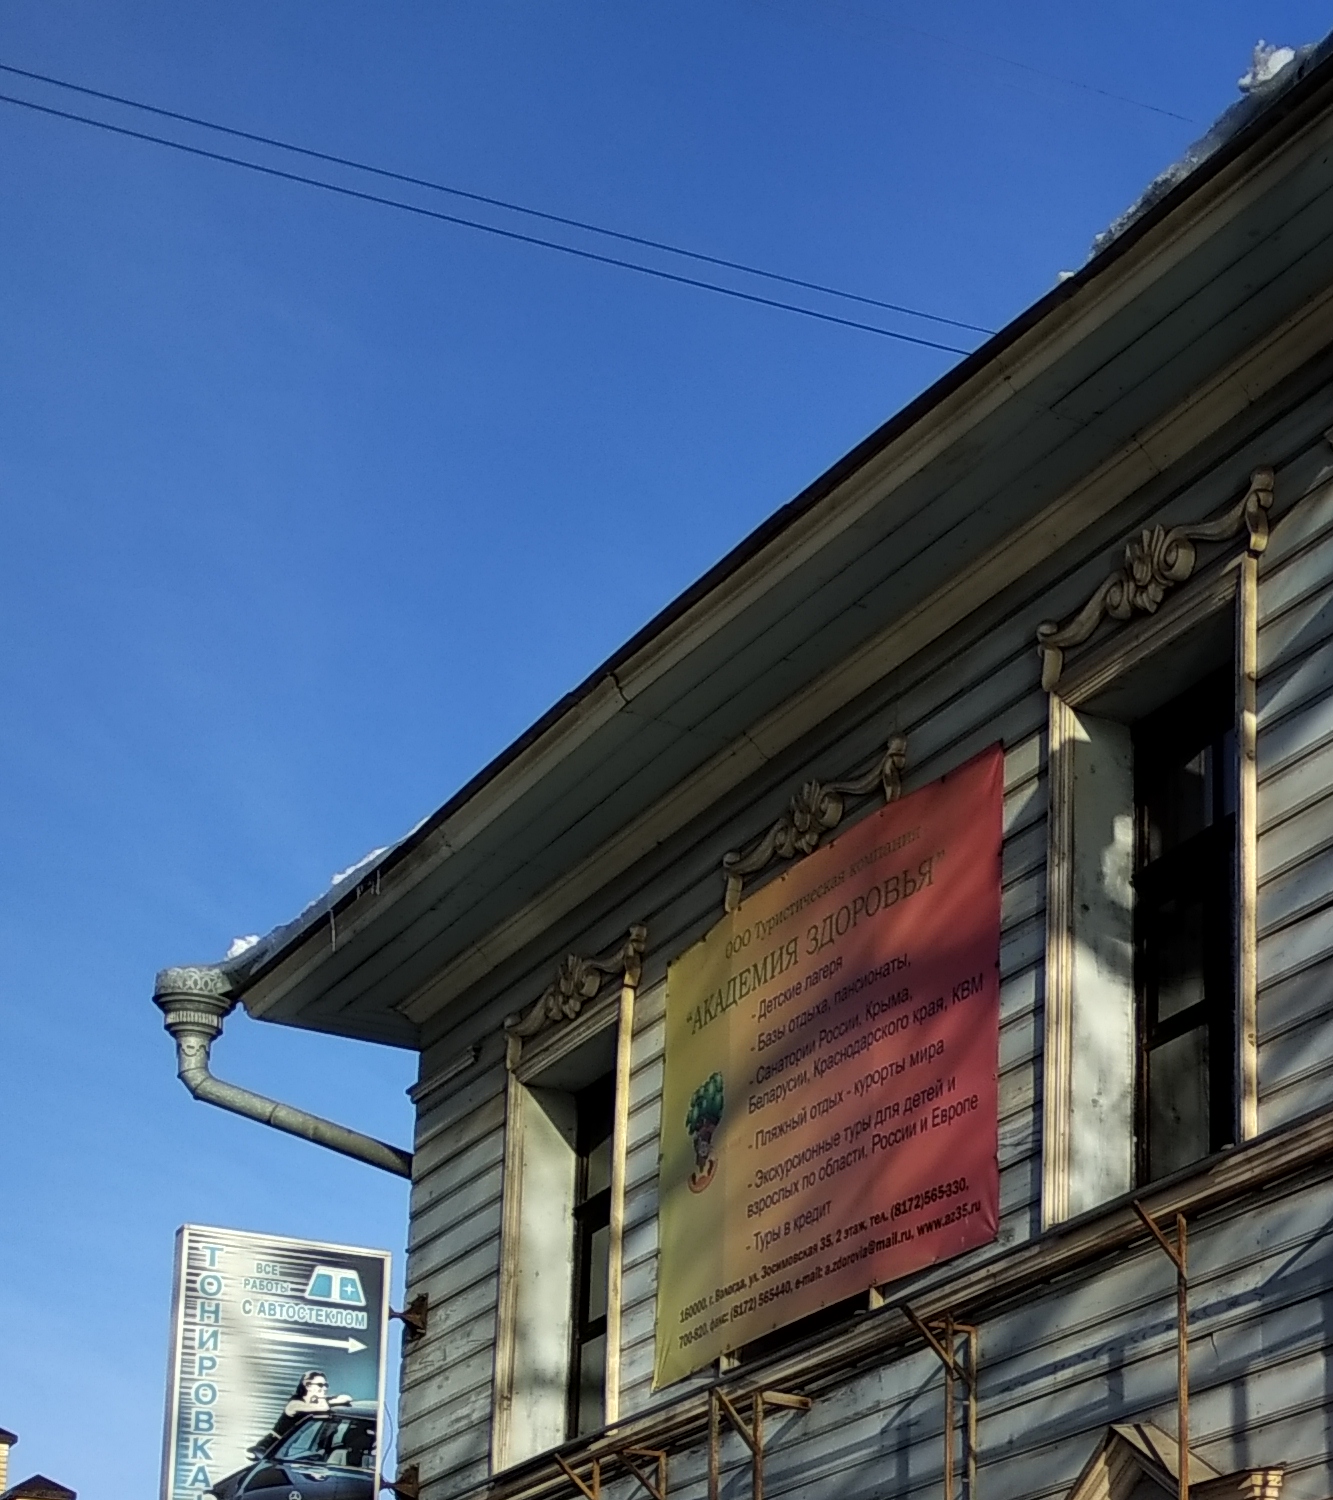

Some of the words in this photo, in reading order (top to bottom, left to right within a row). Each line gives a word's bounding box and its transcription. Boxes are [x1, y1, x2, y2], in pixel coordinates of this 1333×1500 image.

[725, 928, 752, 960] ООО
[754, 871, 845, 938] Туристическая
[849, 826, 921, 877] компания
[756, 1039, 816, 1085] Санатории
[865, 987, 913, 1021] Крыма,
[757, 981, 802, 1023] Детские
[804, 956, 843, 991] лагеря
[757, 1024, 786, 1053] Базы
[788, 998, 831, 1034] отдыха,
[834, 953, 911, 1002] пансионаты,
[813, 1014, 909, 1078] Краснодарского
[912, 996, 948, 1026] края,
[952, 972, 983, 1005] КВМ
[754, 1131, 841, 1189] Экскурсионные
[843, 1115, 872, 1145] туры
[873, 1101, 900, 1129] для
[902, 1078, 943, 1117] детей
[947, 1076, 956, 1093] и
[755, 1106, 807, 1150] Пляжный
[809, 1089, 844, 1121] отдых
[853, 1056, 906, 1098] курорты
[909, 1039, 945, 1068] мира
[747, 1180, 799, 1219] взрослых
[801, 1171, 816, 1191] по
[871, 1121, 917, 1154] России
[920, 1116, 928, 1134] и
[931, 1093, 979, 1128] Европе
[255, 1262, 278, 1276] ВСЕ
[730, 1296, 757, 1322] (8172)
[916, 1199, 981, 1237] www.az35.ru
[753, 1225, 781, 1254] Туры
[783, 1221, 792, 1237] в
[793, 1200, 832, 1234] кредит
[835, 1228, 843, 1244] 2
[869, 1211, 889, 1227] тел.
[241, 1299, 253, 1315] С
[257, 1301, 367, 1328] АВТОСТЕКЛОМ
[243, 1278, 290, 1293] РАБОТЫ
